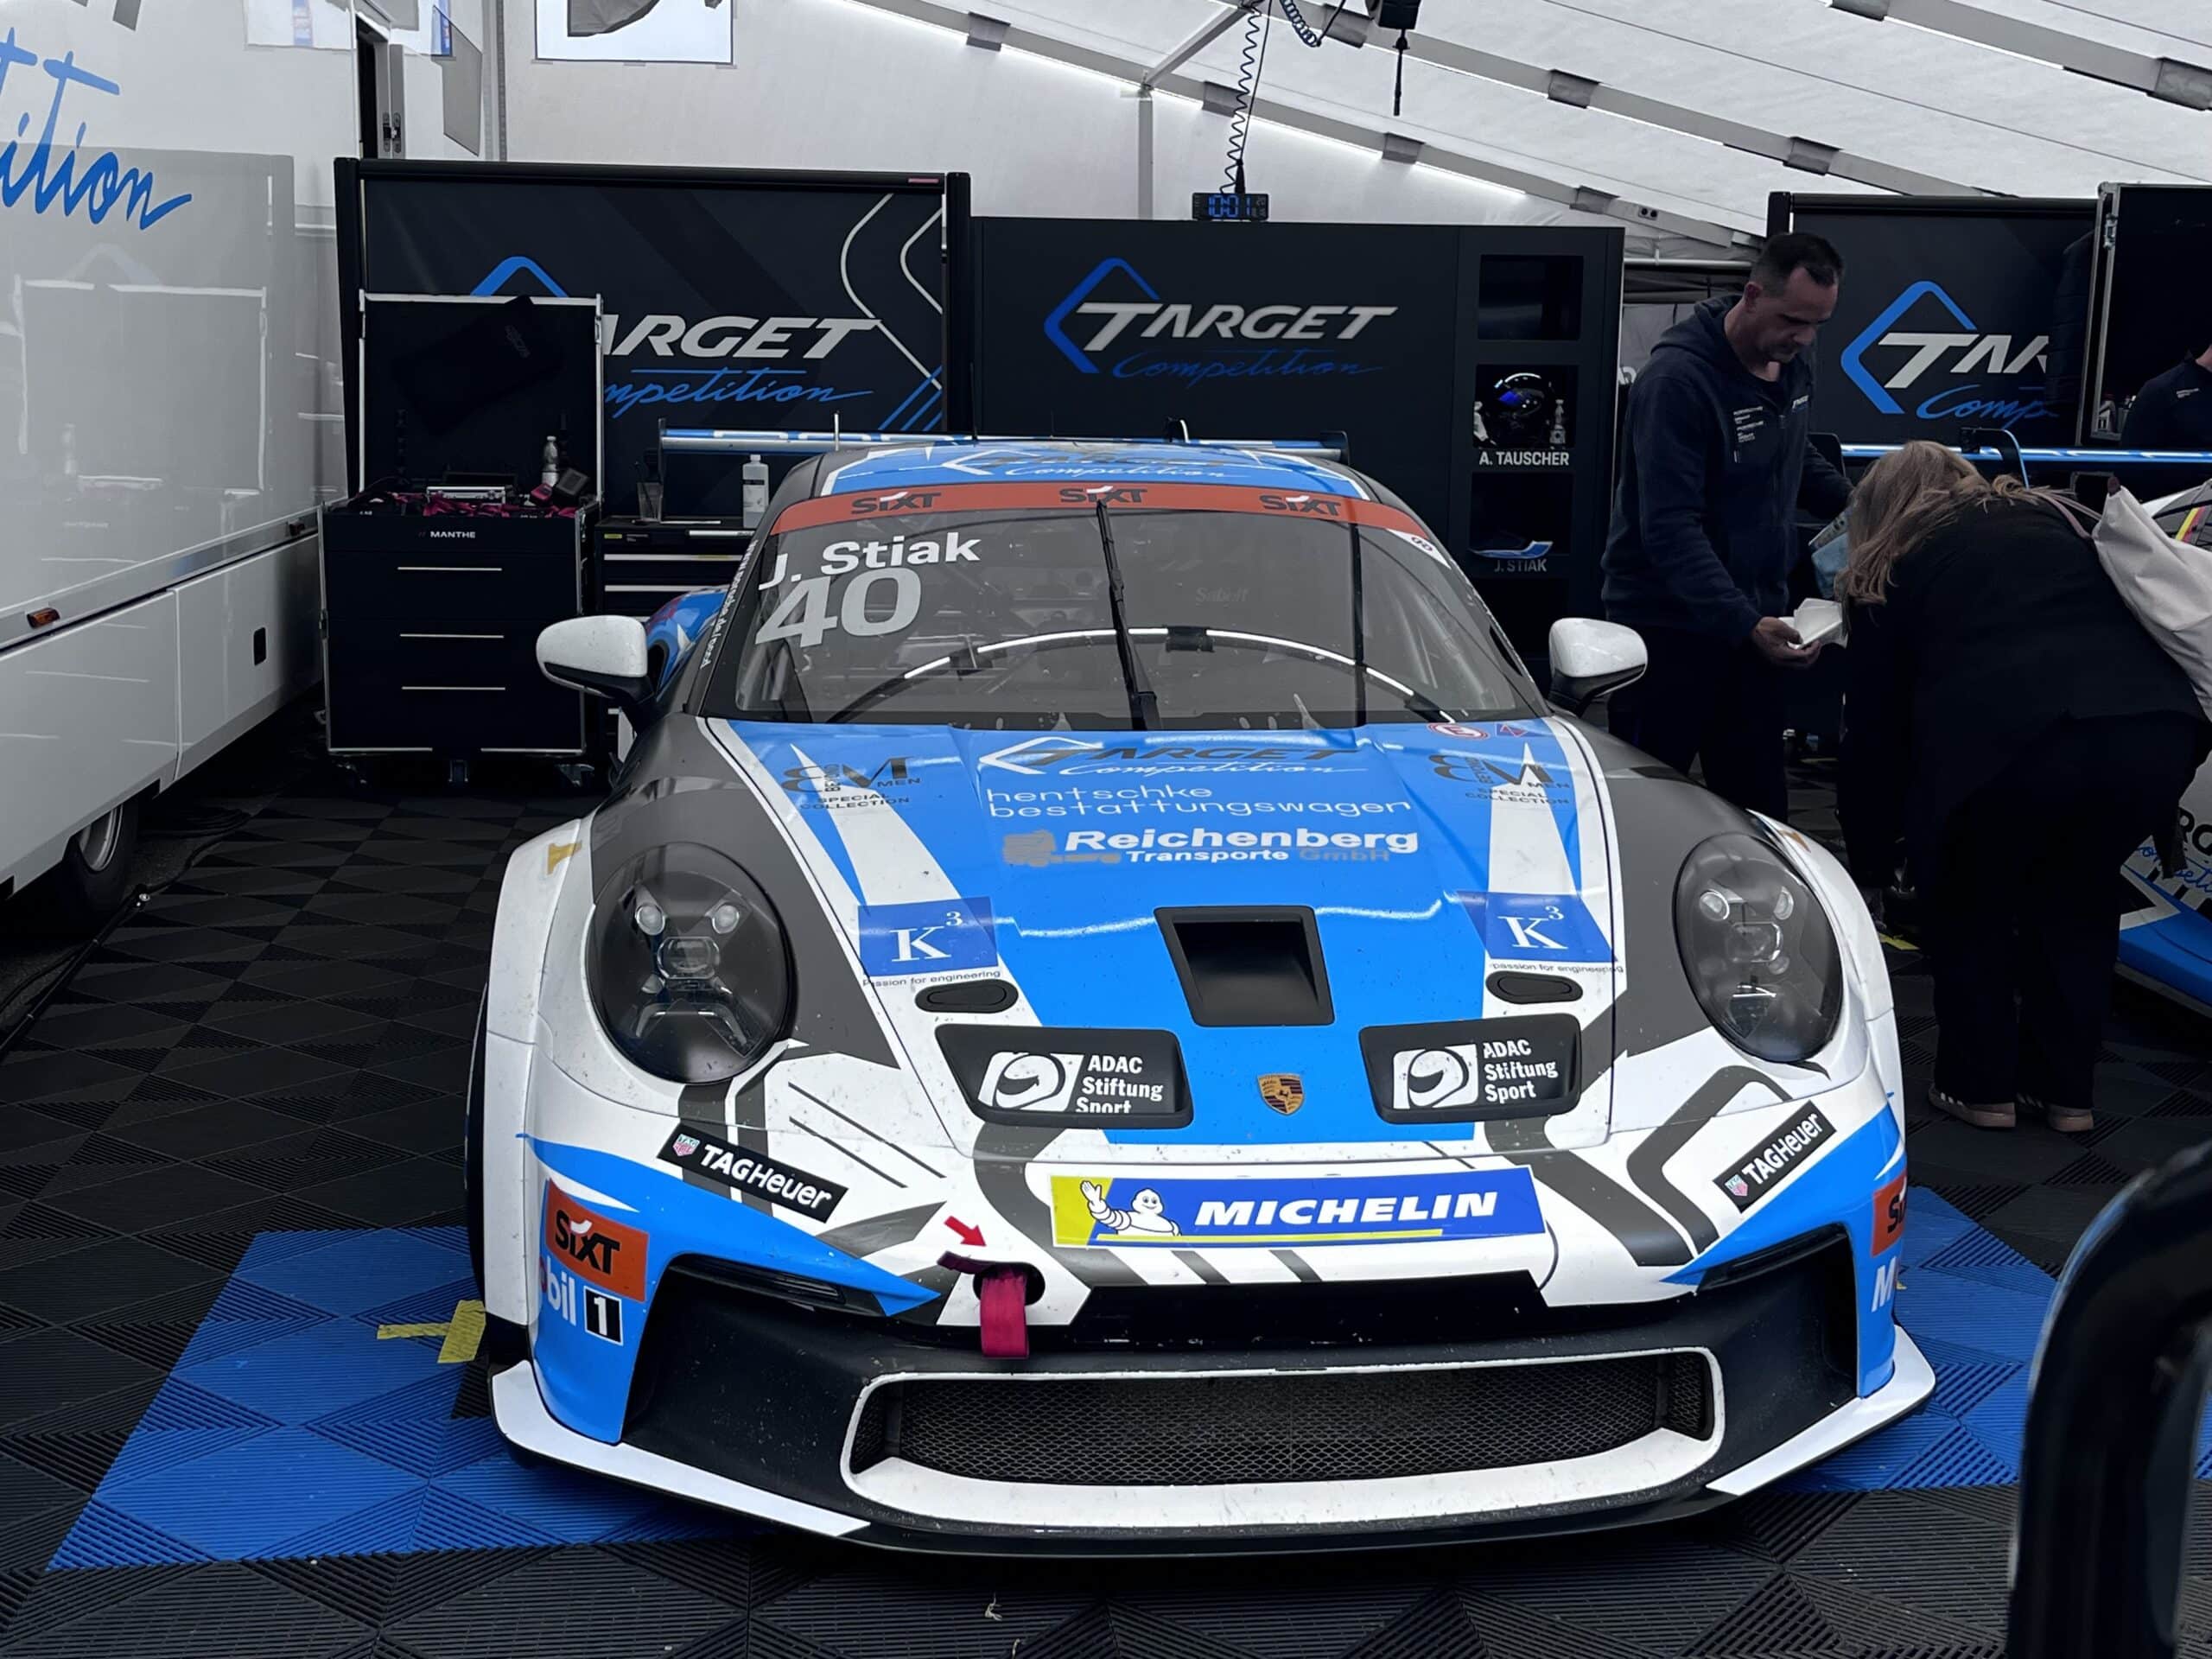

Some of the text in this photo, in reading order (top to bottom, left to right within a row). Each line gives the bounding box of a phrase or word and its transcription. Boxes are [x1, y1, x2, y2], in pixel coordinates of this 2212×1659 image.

[602, 315, 881, 359] RGET
[1077, 302, 1398, 352] TARGET
[1112, 347, 1384, 389] Competition
[1479, 452, 1569, 466] A. TAUSCHER
[851, 492, 941, 514] SIXT
[1059, 485, 1147, 503] SIXT
[1260, 495, 1341, 517] SIXT
[759, 532, 981, 591] J. Stiak
[1495, 559, 1548, 572] J. STIAK
[755, 568, 922, 648] 40
[1059, 761, 1369, 777] Competition
[877, 779, 921, 787] MEN
[987, 784, 1212, 802] hentschke
[1478, 786, 1548, 798] SPECIAL
[800, 798, 910, 810] COLLECTION
[820, 793, 889, 803] SPECIAL
[1465, 791, 1569, 804] COLLECTION
[989, 800, 1412, 817] bestattungswagen
[1065, 827, 1419, 854] Reichenberg
[1126, 849, 1290, 863] Transporte
[911, 977, 926, 986] for
[931, 969, 1001, 983] engineering
[1483, 1039, 1532, 1058] ADAC
[1088, 1054, 1143, 1074] ADAC
[1484, 1061, 1559, 1081] Stiftung
[1081, 1076, 1164, 1102] Stiftung
[1484, 1081, 1536, 1103] Sport
[1194, 1192, 1498, 1226] MICHELIN
[555, 1210, 620, 1275] SIXT
[540, 1255, 607, 1336] bil 1
